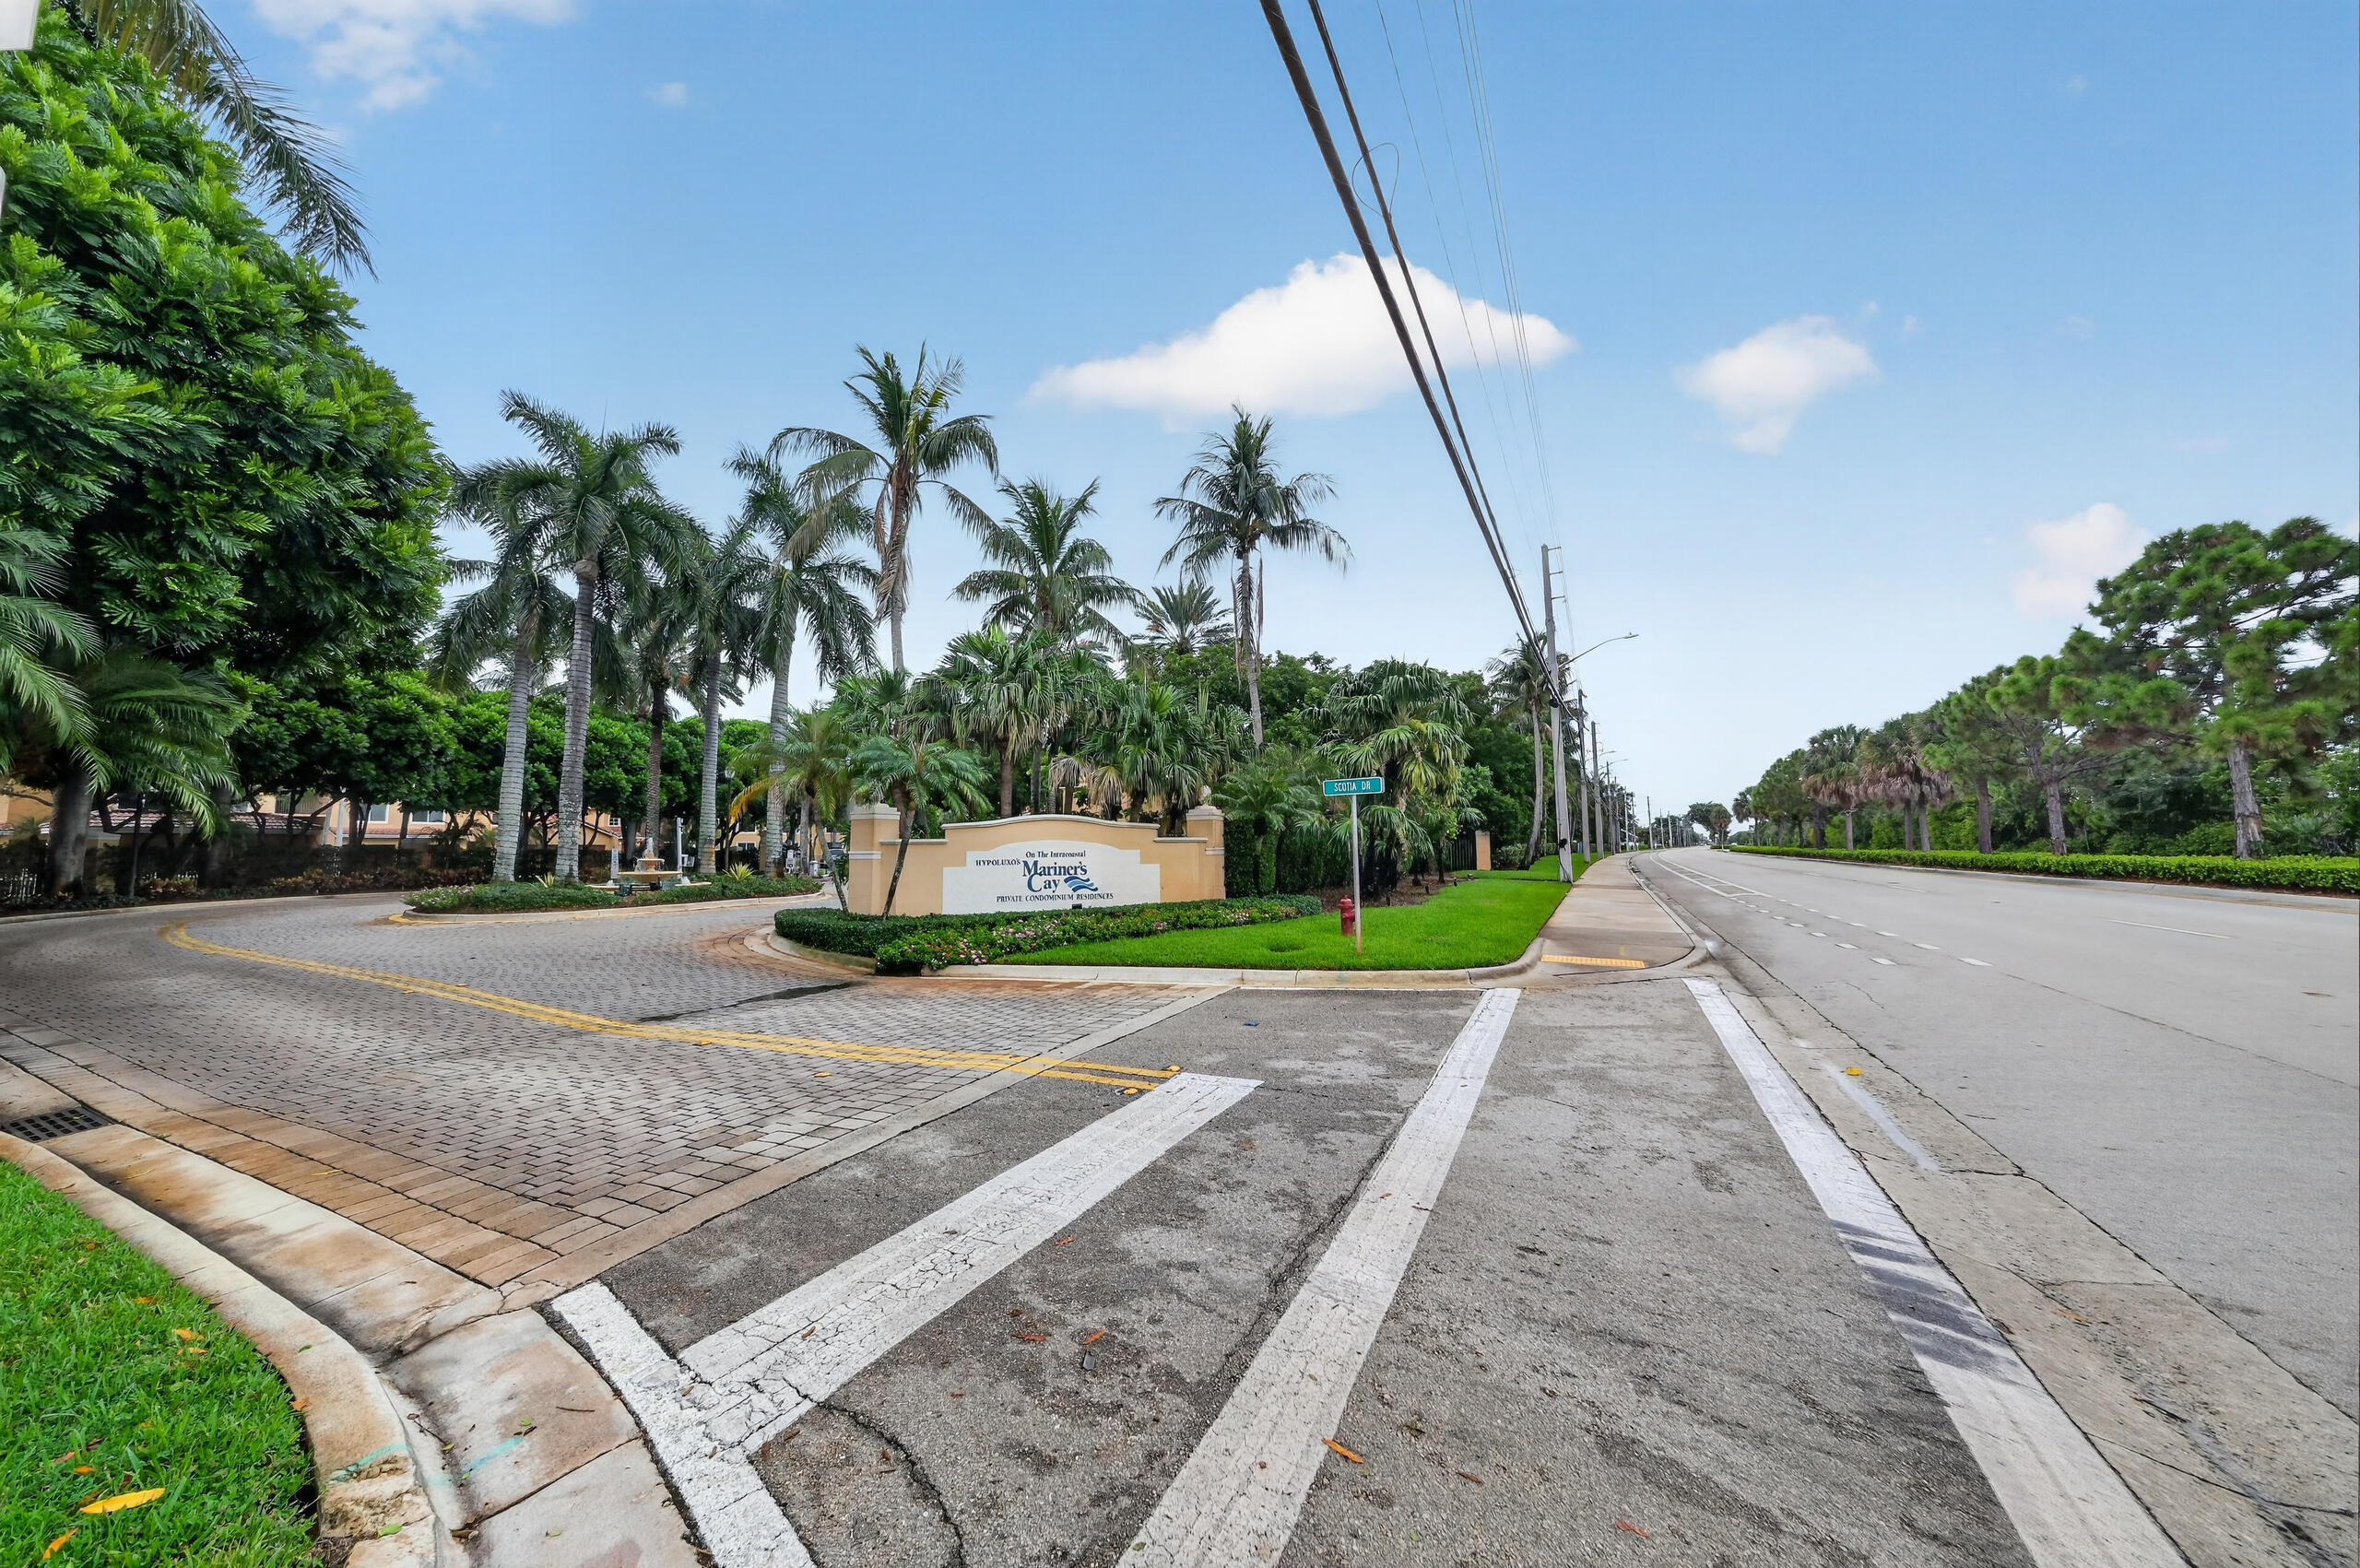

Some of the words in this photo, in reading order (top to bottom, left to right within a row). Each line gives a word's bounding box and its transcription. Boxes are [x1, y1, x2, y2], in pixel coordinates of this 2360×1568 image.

[1334, 782, 1357, 792] SCOTIA
[1362, 781, 1371, 790] DR
[1050, 850, 1086, 858] Intracoastal
[1022, 860, 1088, 877] Mariner's
[1027, 873, 1060, 892] Cay
[1025, 893, 1074, 902] CONDOMINIUM
[1076, 892, 1114, 901] RESIDENCES
